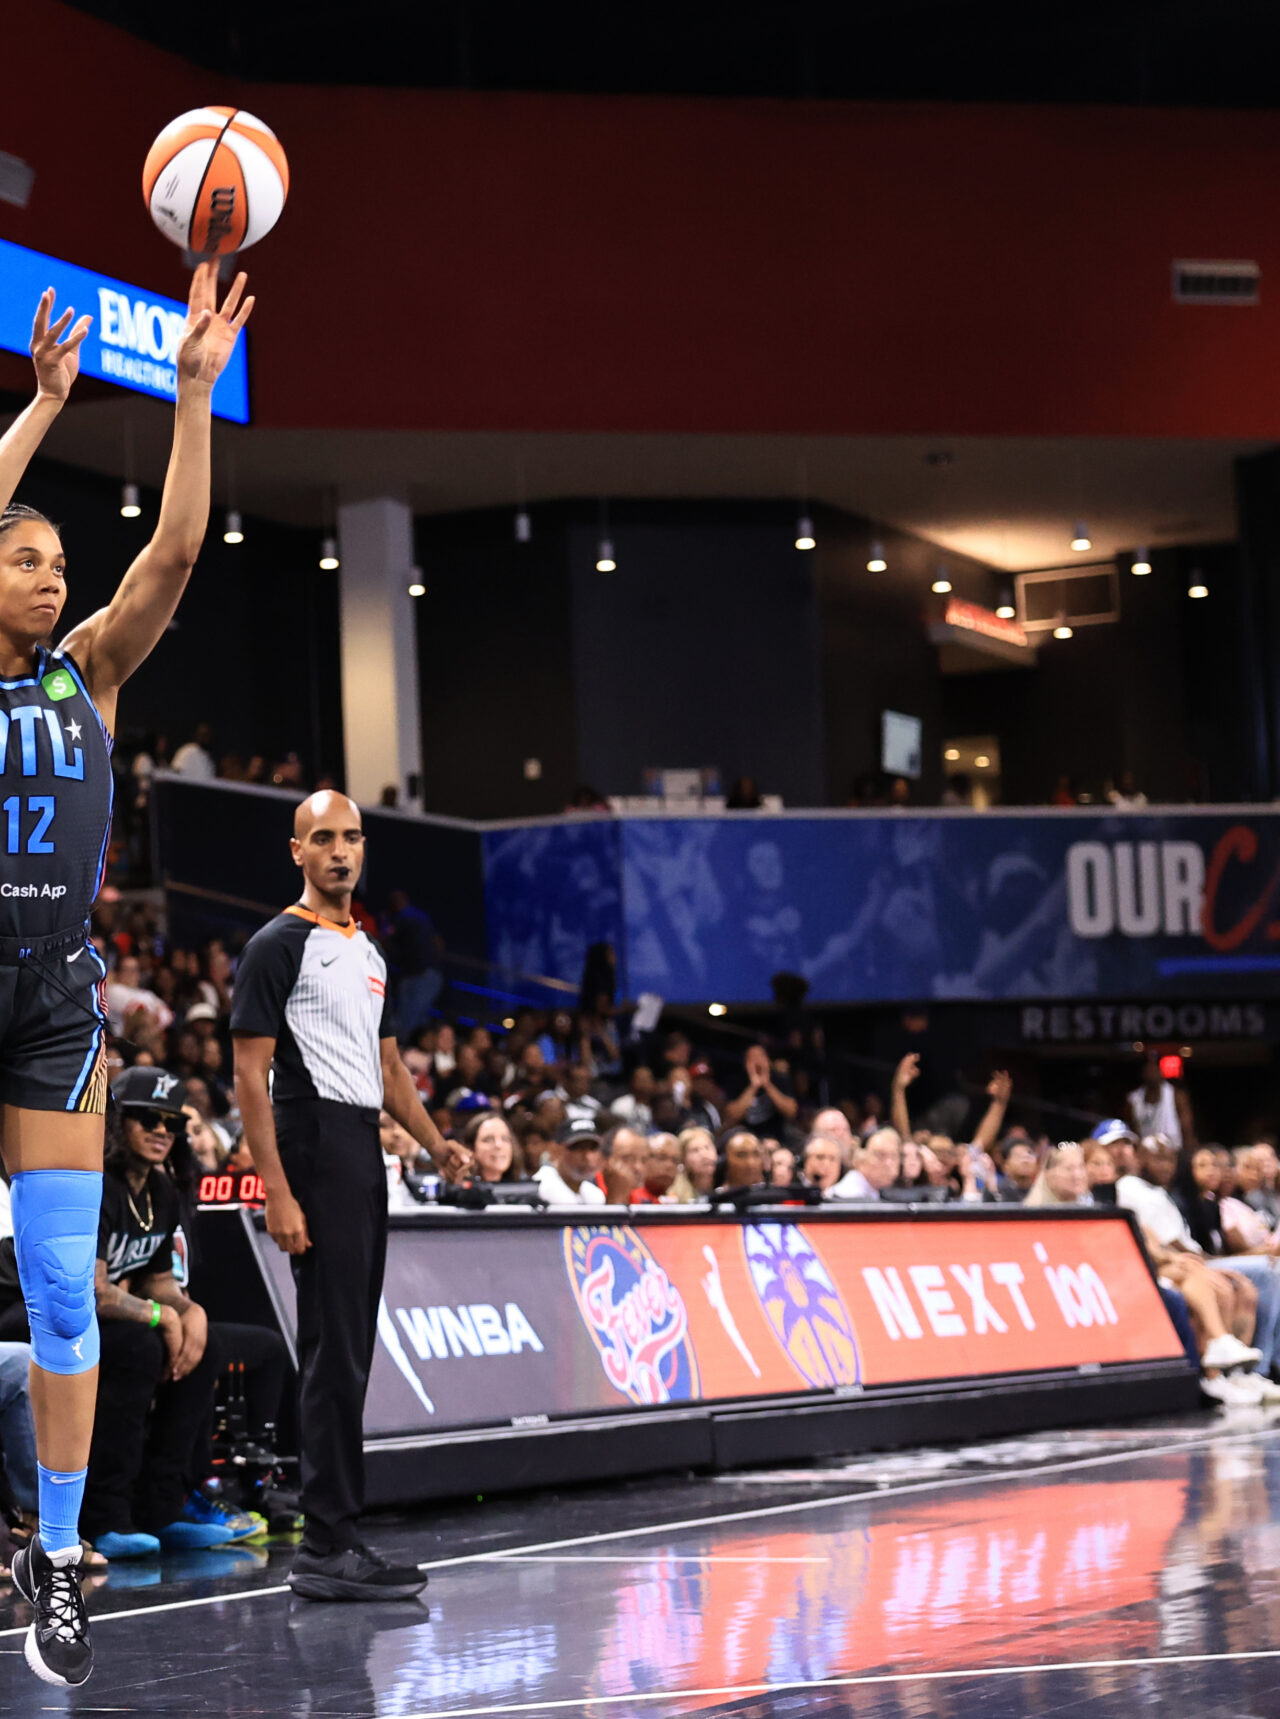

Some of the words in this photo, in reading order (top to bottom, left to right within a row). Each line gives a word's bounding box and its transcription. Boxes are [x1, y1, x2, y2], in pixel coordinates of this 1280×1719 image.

[3, 796, 55, 854] 12
[0, 884, 37, 899] Cash
[41, 884, 67, 900] App
[1066, 840, 1205, 939] OUR
[1021, 1003, 1266, 1039] RESTROOMS
[861, 1262, 1036, 1341] NEXT
[1033, 1241, 1119, 1329] ion
[396, 1302, 545, 1360] WNBA
